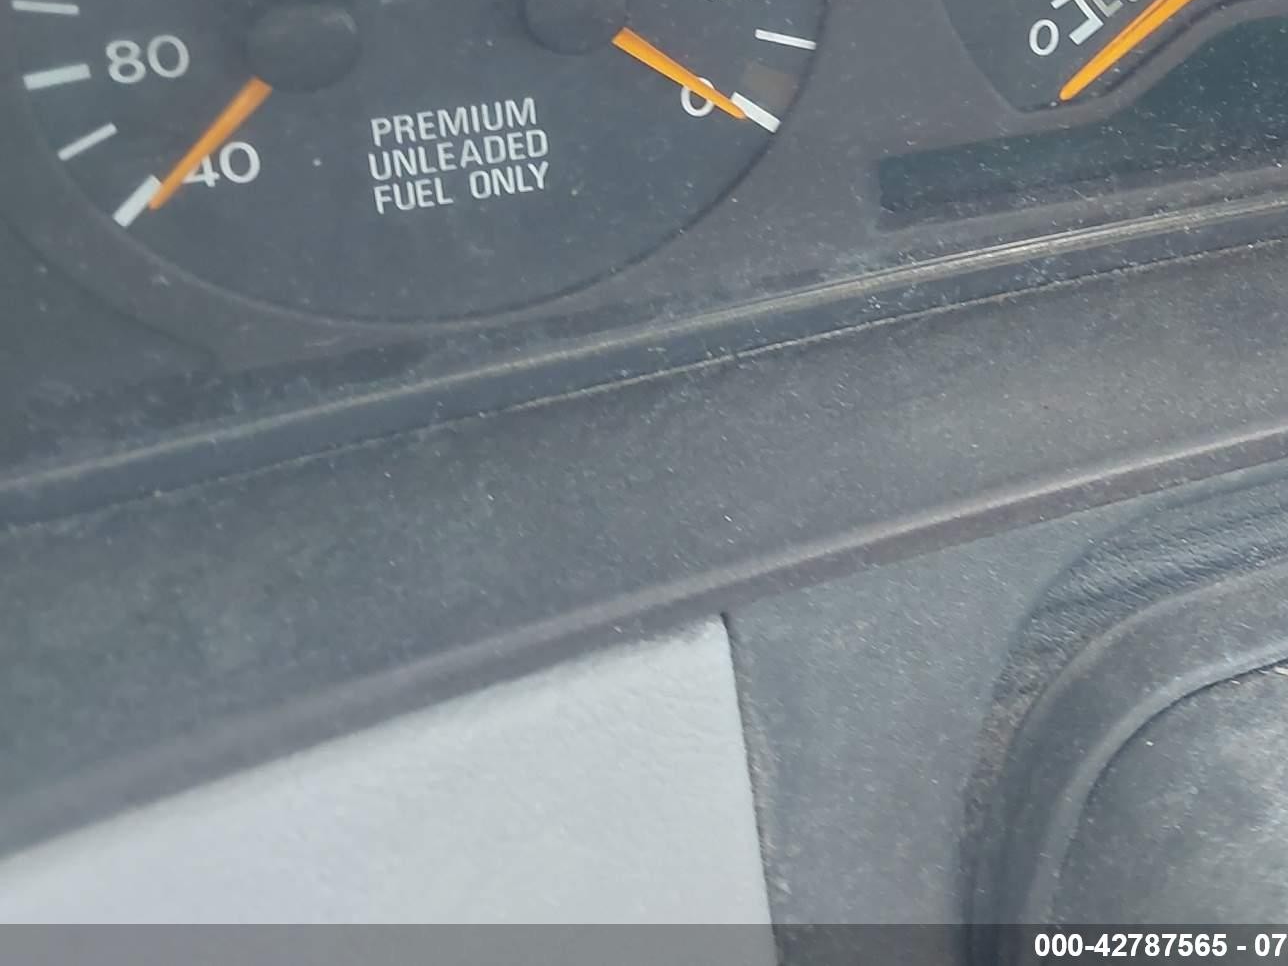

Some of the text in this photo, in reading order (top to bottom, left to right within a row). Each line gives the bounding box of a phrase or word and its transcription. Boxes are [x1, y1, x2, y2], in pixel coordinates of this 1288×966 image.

[105, 36, 188, 83] 80
[1029, 19, 1059, 56] 0
[371, 98, 537, 145] PREMIUM
[184, 141, 260, 188] 40
[369, 129, 547, 180] UNLEADED
[375, 162, 549, 214] FUEL ONLY
